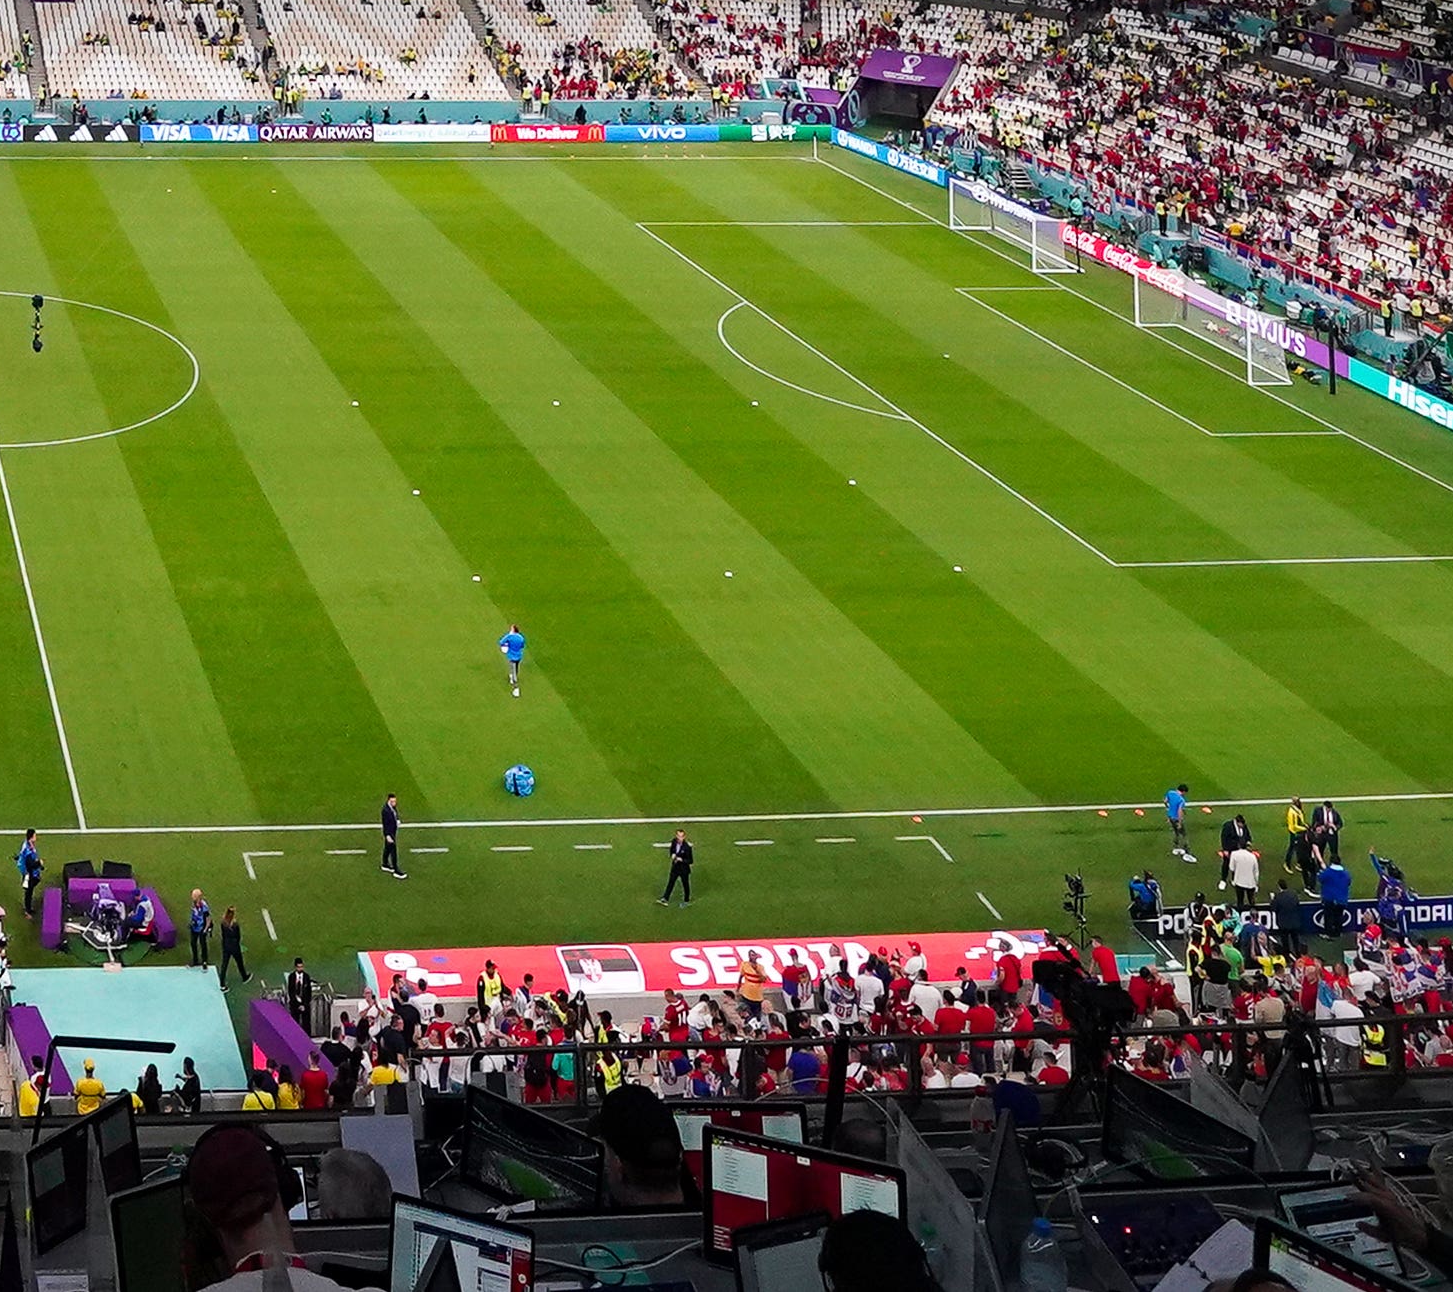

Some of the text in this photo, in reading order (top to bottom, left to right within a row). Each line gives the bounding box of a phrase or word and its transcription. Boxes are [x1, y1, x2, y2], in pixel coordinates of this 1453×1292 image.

[152, 124, 192, 141] VISA
[206, 124, 251, 141] VISA
[260, 126, 373, 140] QATAR AIRWAYS
[516, 128, 579, 140] We Deliver
[637, 127, 686, 140] vivo
[848, 135, 878, 156] WANDA
